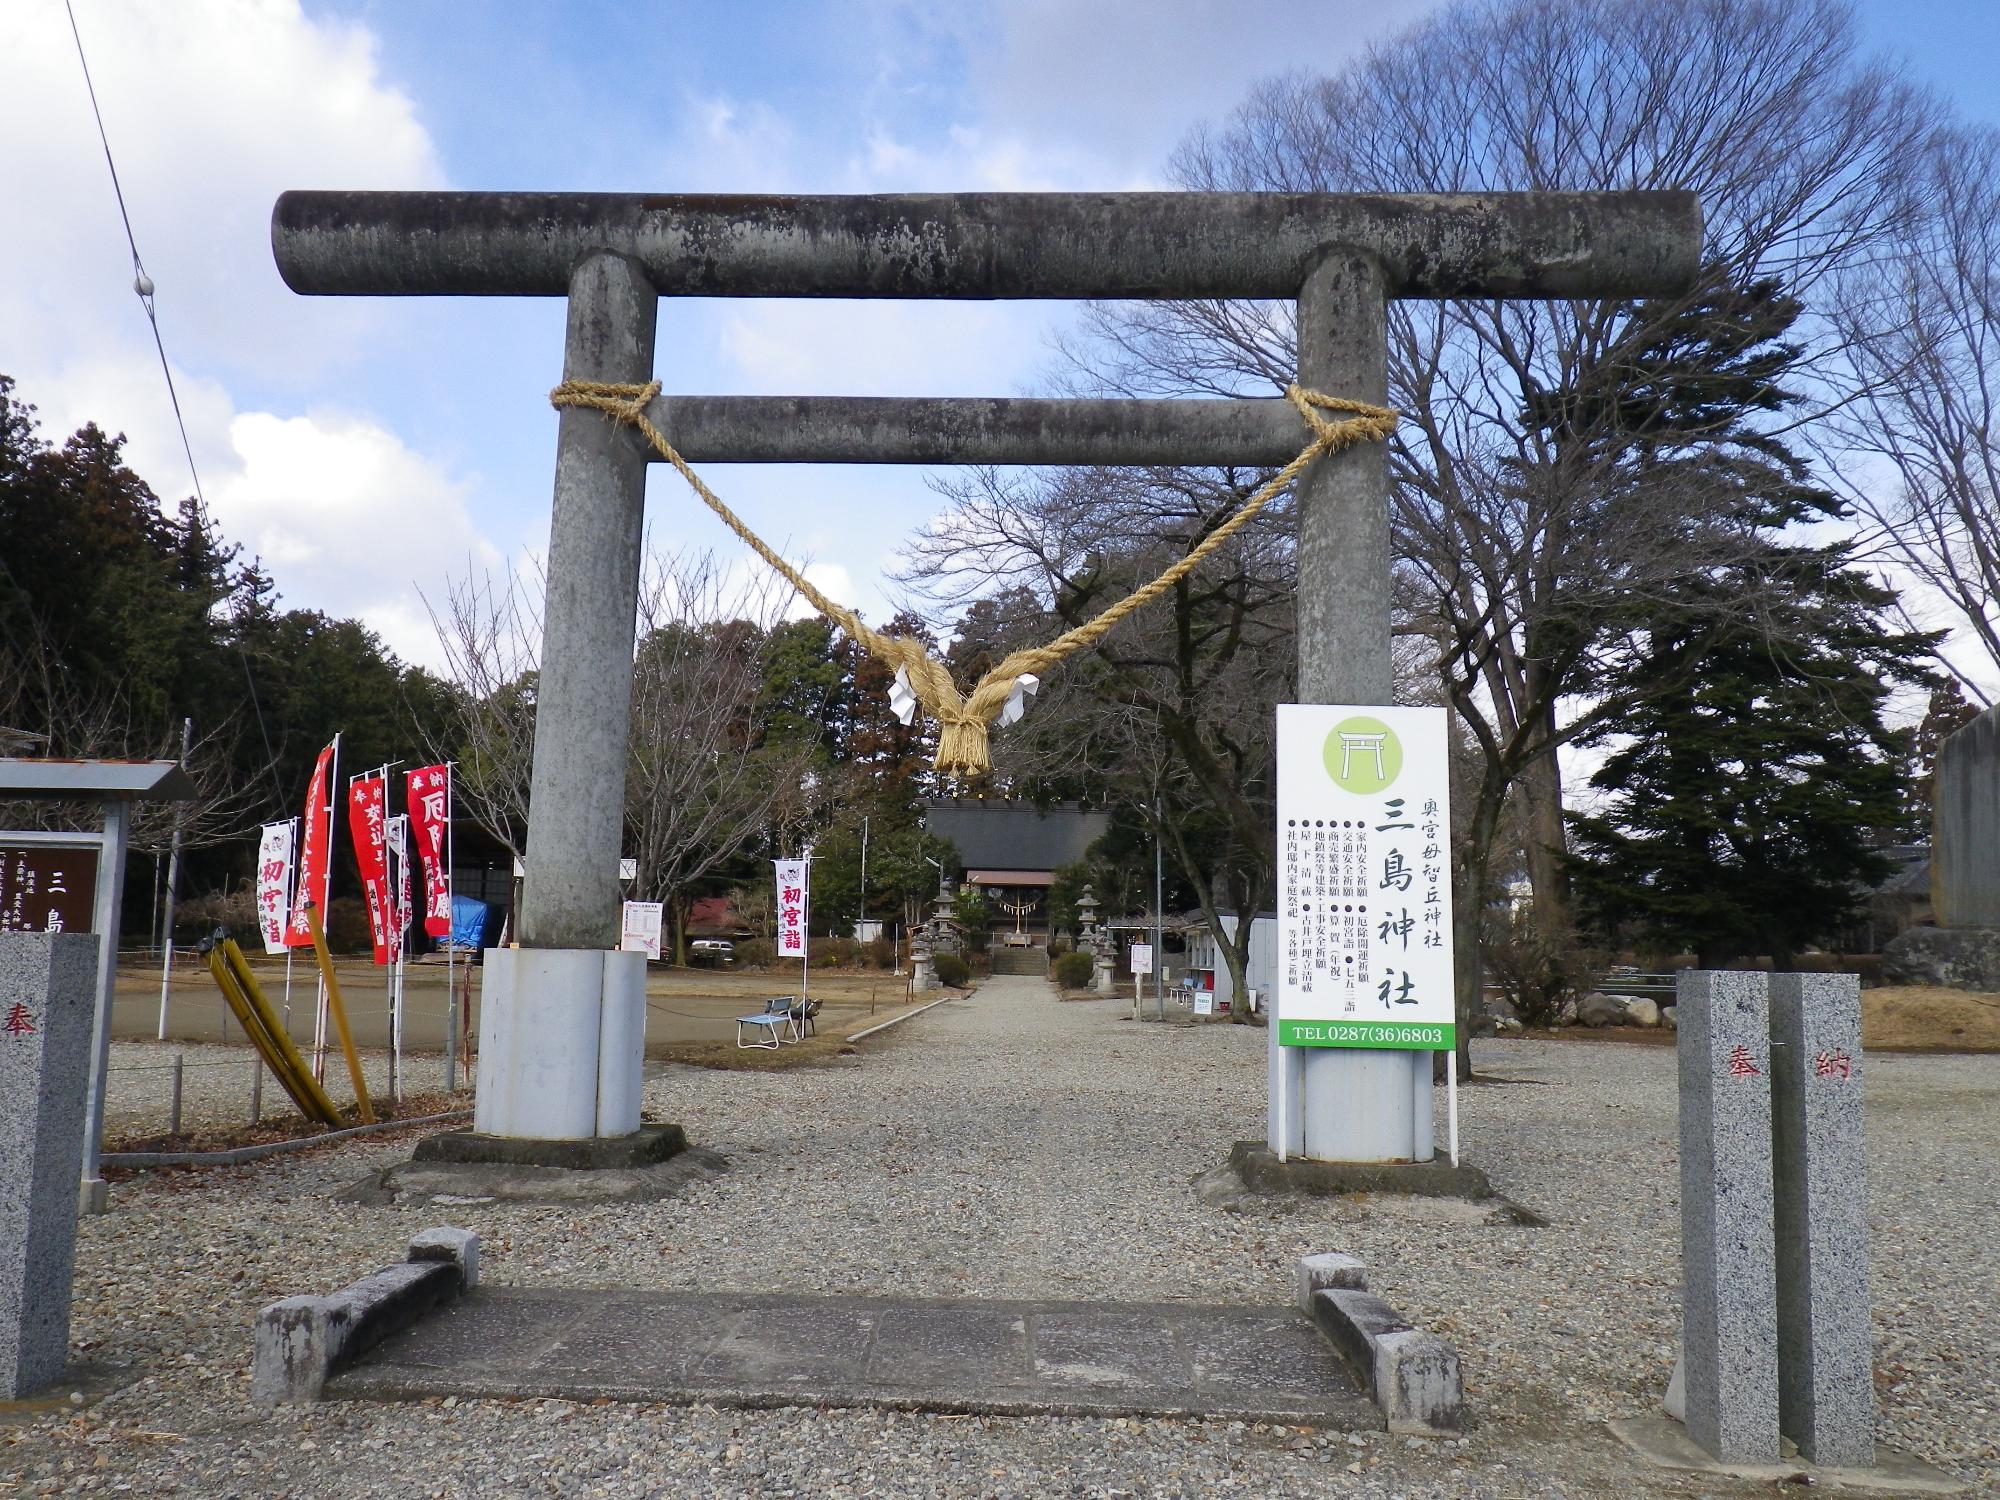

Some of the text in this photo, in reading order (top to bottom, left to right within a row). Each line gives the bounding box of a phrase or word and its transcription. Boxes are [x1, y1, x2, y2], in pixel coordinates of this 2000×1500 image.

[1328, 831, 1339, 896] 商売繁盛祈願
[44, 871, 67, 933] 三島
[782, 885, 801, 949] 初宮詣
[1342, 831, 1355, 1012] 交通安全祈願 初宮詣 七五三詣
[1356, 832, 1368, 983] 家内安全祈願 厄除開運祈願
[1375, 798, 1418, 1009] 三島神社
[1, 1002, 37, 1037] 奉
[1293, 1026, 1442, 1043] TEL 0287(36)6803
[1729, 1044, 1760, 1081] 奉
[1816, 1046, 1851, 1081] 納
